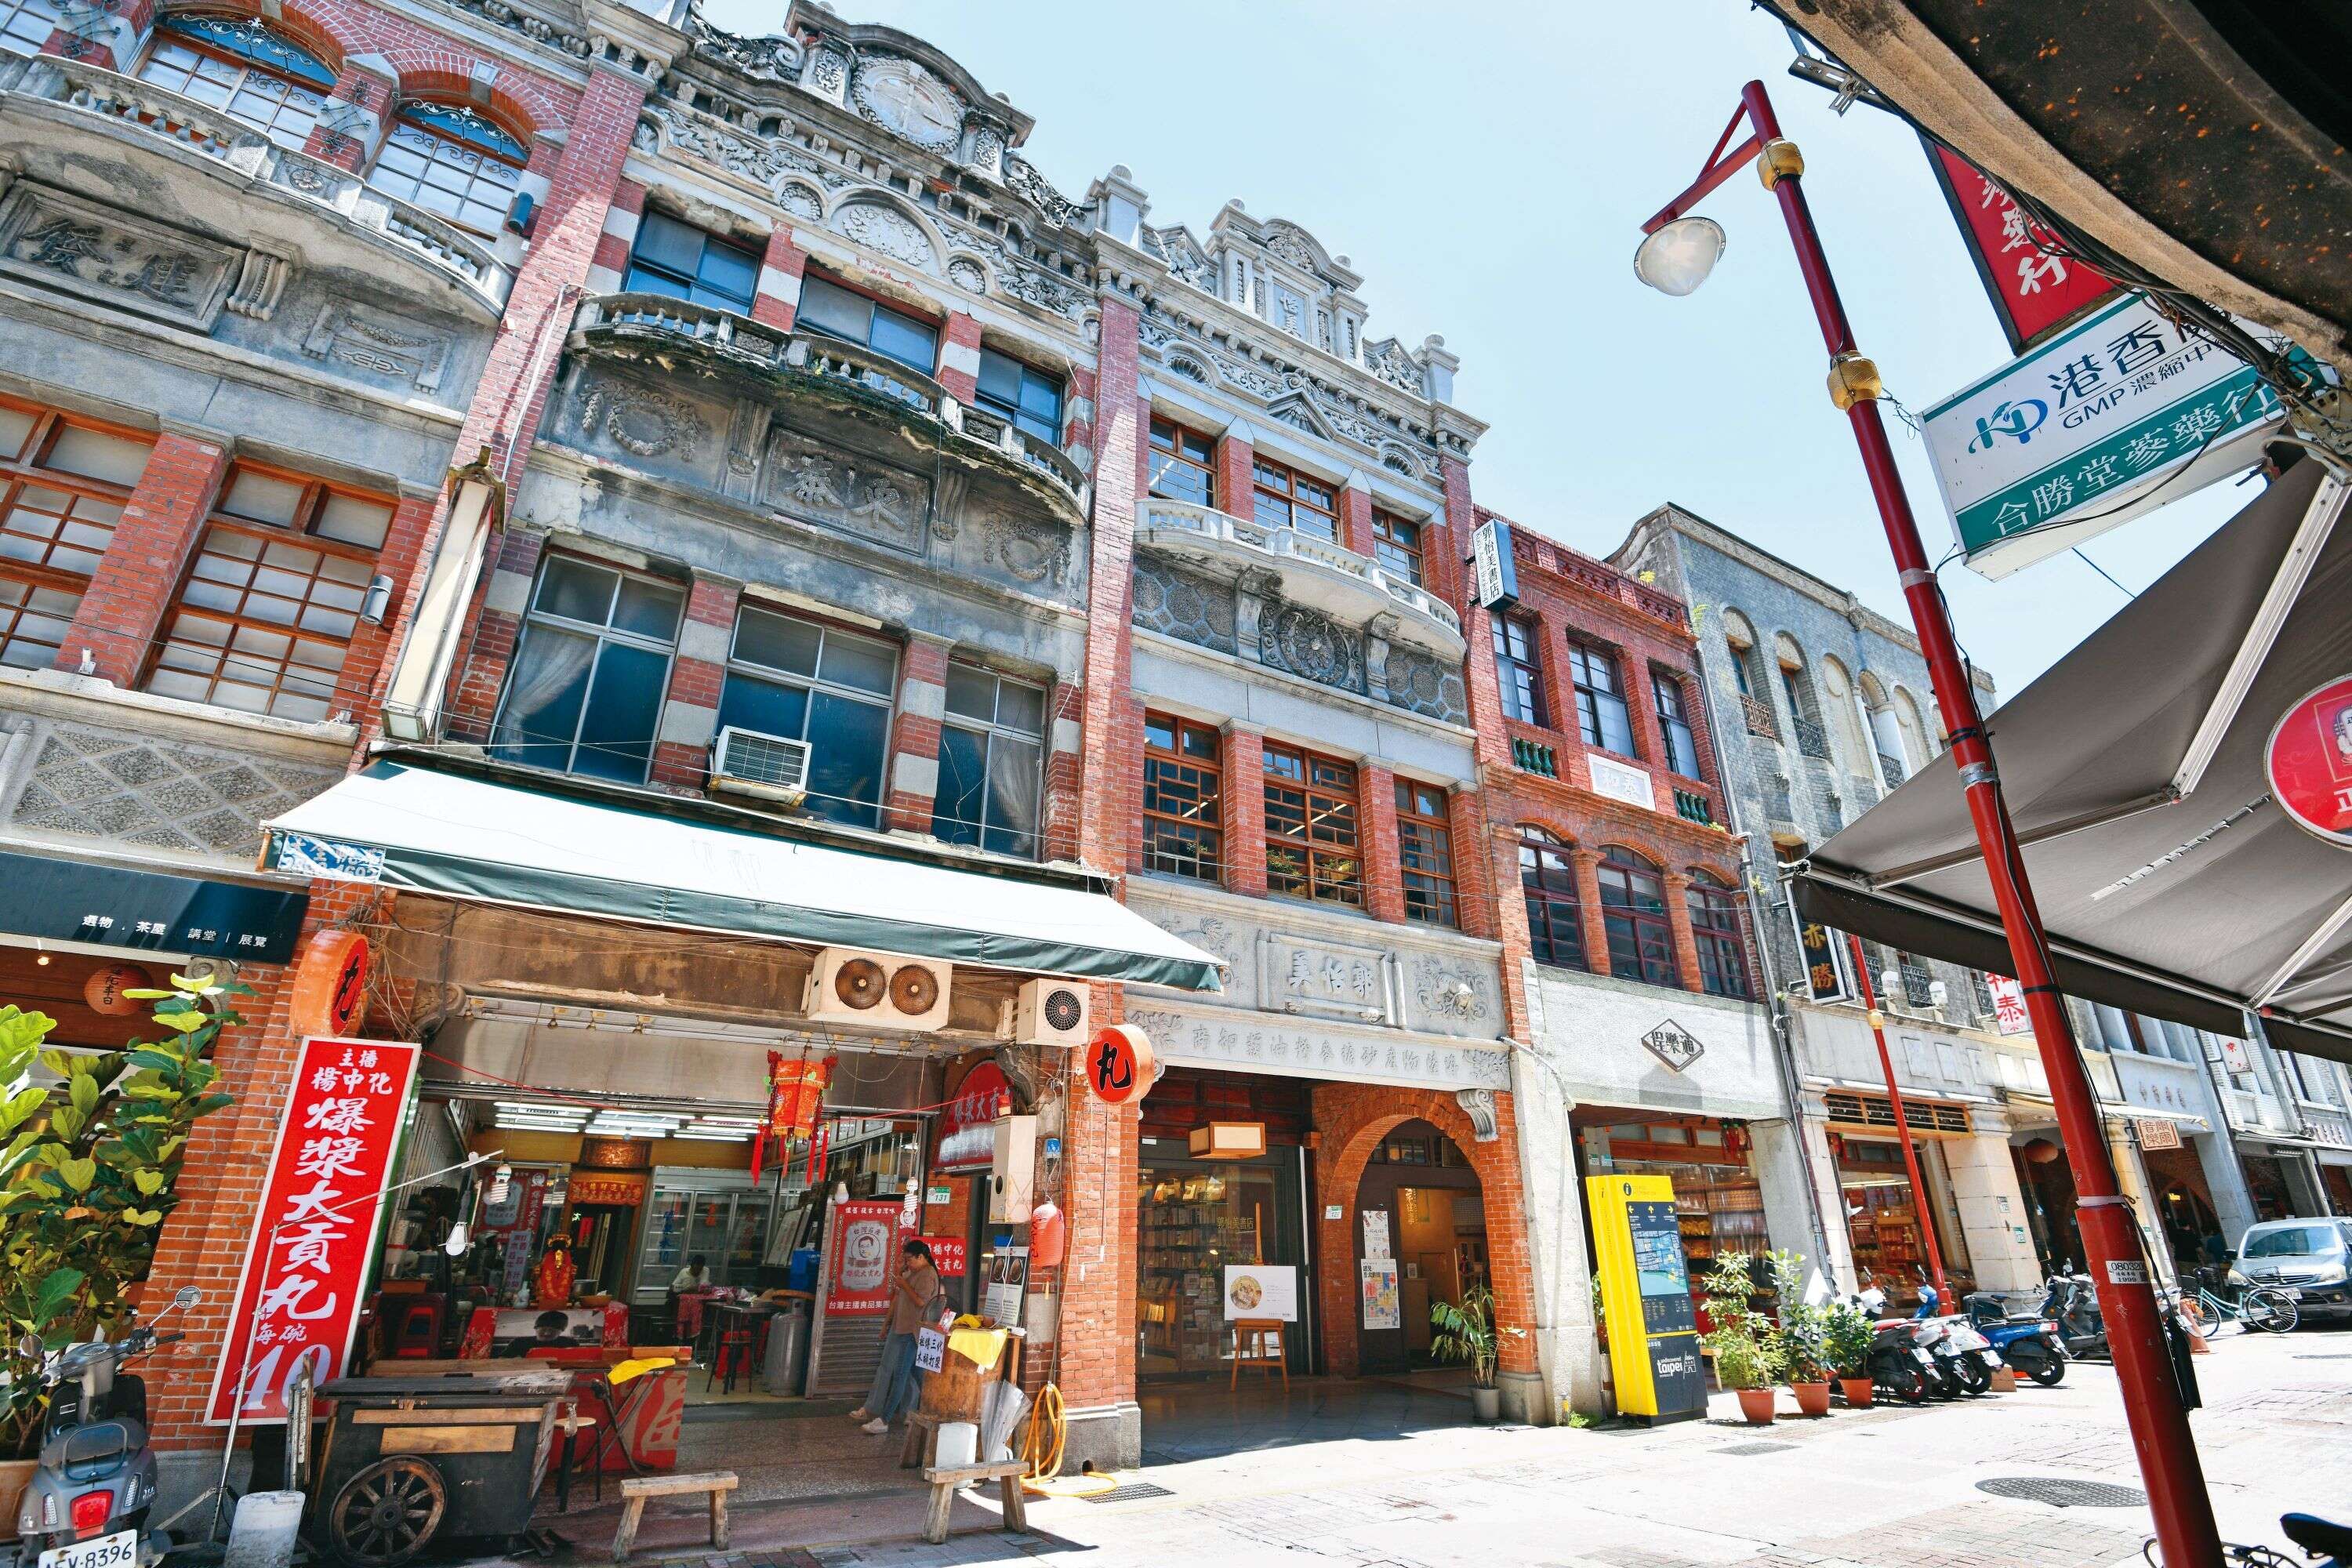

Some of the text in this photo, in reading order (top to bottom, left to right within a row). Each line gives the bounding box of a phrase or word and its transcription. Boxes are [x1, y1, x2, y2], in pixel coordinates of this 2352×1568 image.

[2063, 339, 2228, 429] GMP 濃縮中
[1482, 524, 1500, 601] 郭怡美書店
[82, 915, 267, 948] 選物 茶屋 講堂 展覽
[333, 954, 360, 1023] 丸
[339, 1048, 379, 1069] 主播
[1098, 1042, 1133, 1091] 丸
[311, 1066, 393, 1095] 楊中化
[954, 1086, 1011, 1124] 爆漿大貢
[263, 1097, 376, 1320] 爆漿大貢丸
[255, 1323, 307, 1345] 每碗
[1657, 1359, 1683, 1377] taipei
